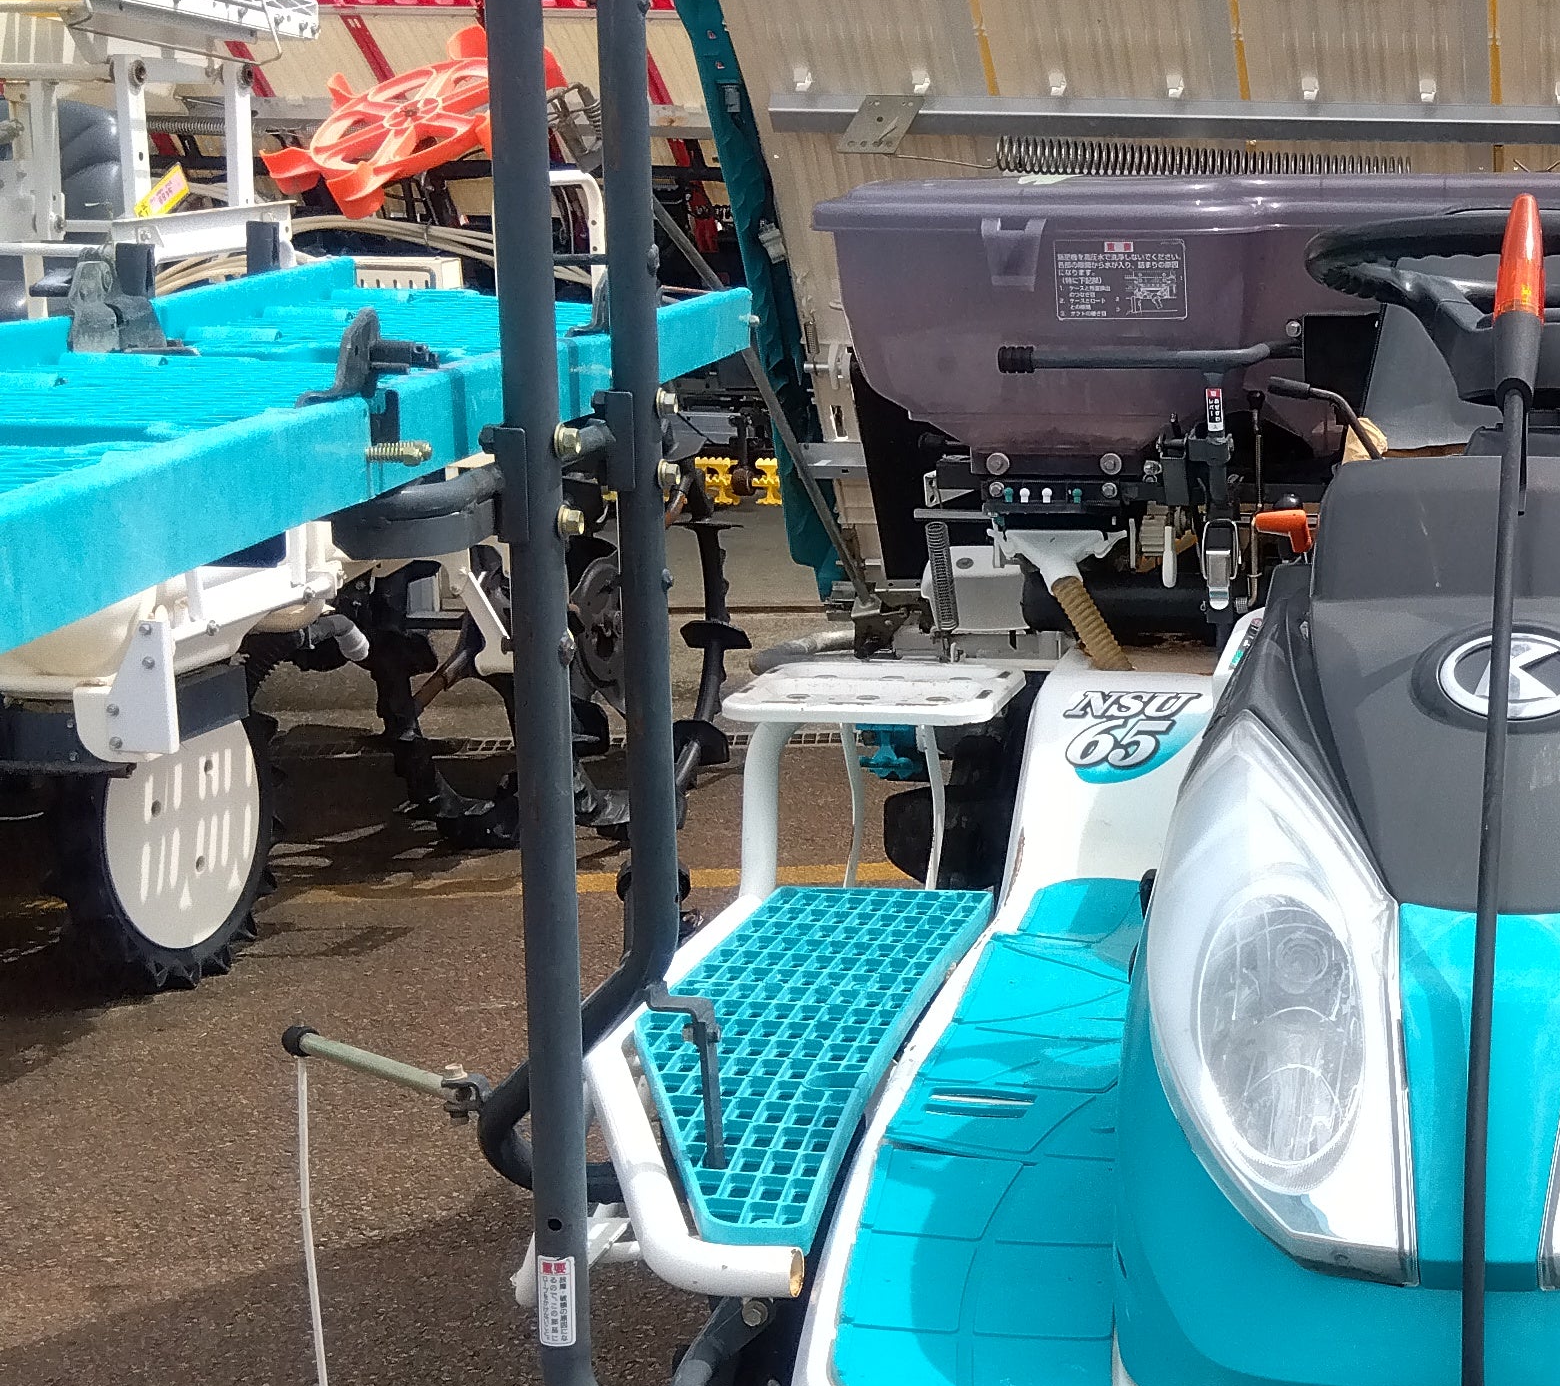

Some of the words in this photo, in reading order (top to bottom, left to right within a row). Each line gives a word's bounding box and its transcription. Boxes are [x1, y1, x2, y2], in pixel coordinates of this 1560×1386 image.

[1063, 690, 1203, 719] NSU
[1065, 718, 1177, 768] 65
[543, 1262, 566, 1275] 重要
